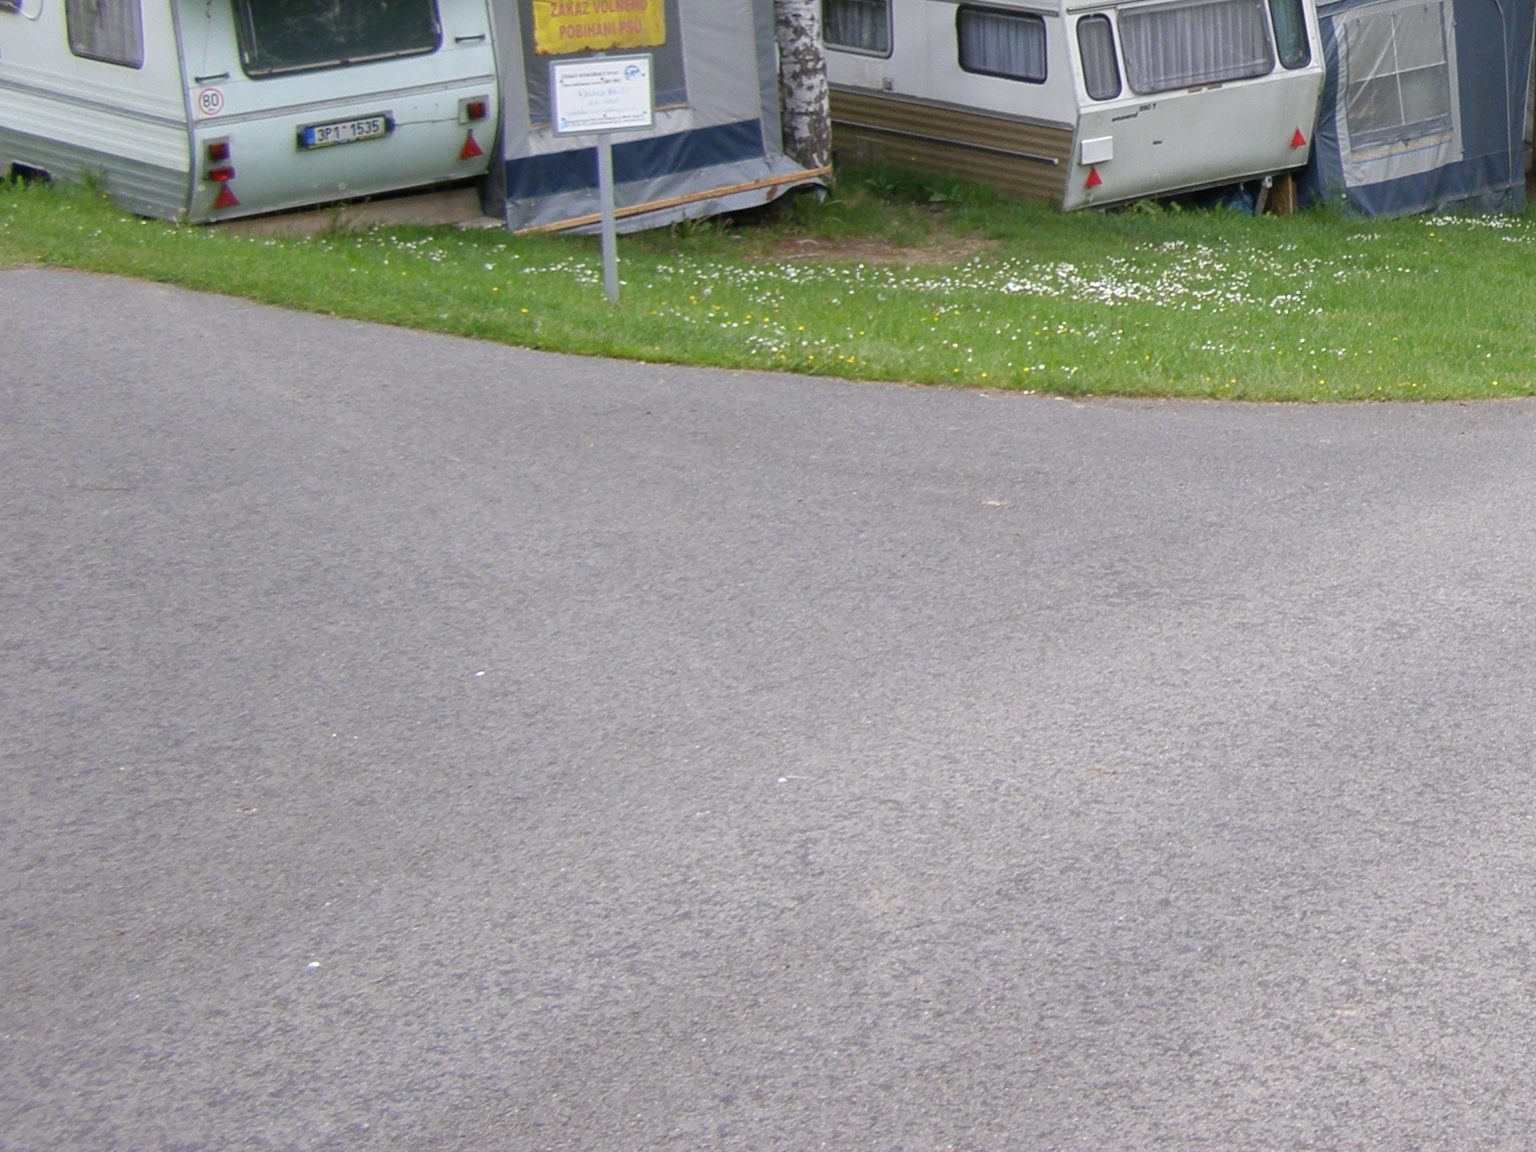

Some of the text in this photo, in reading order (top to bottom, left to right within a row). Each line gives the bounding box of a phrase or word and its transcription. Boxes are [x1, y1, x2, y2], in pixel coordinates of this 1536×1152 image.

[203, 93, 220, 108] 80
[318, 126, 340, 142] 3P1
[351, 120, 380, 136] 1535
